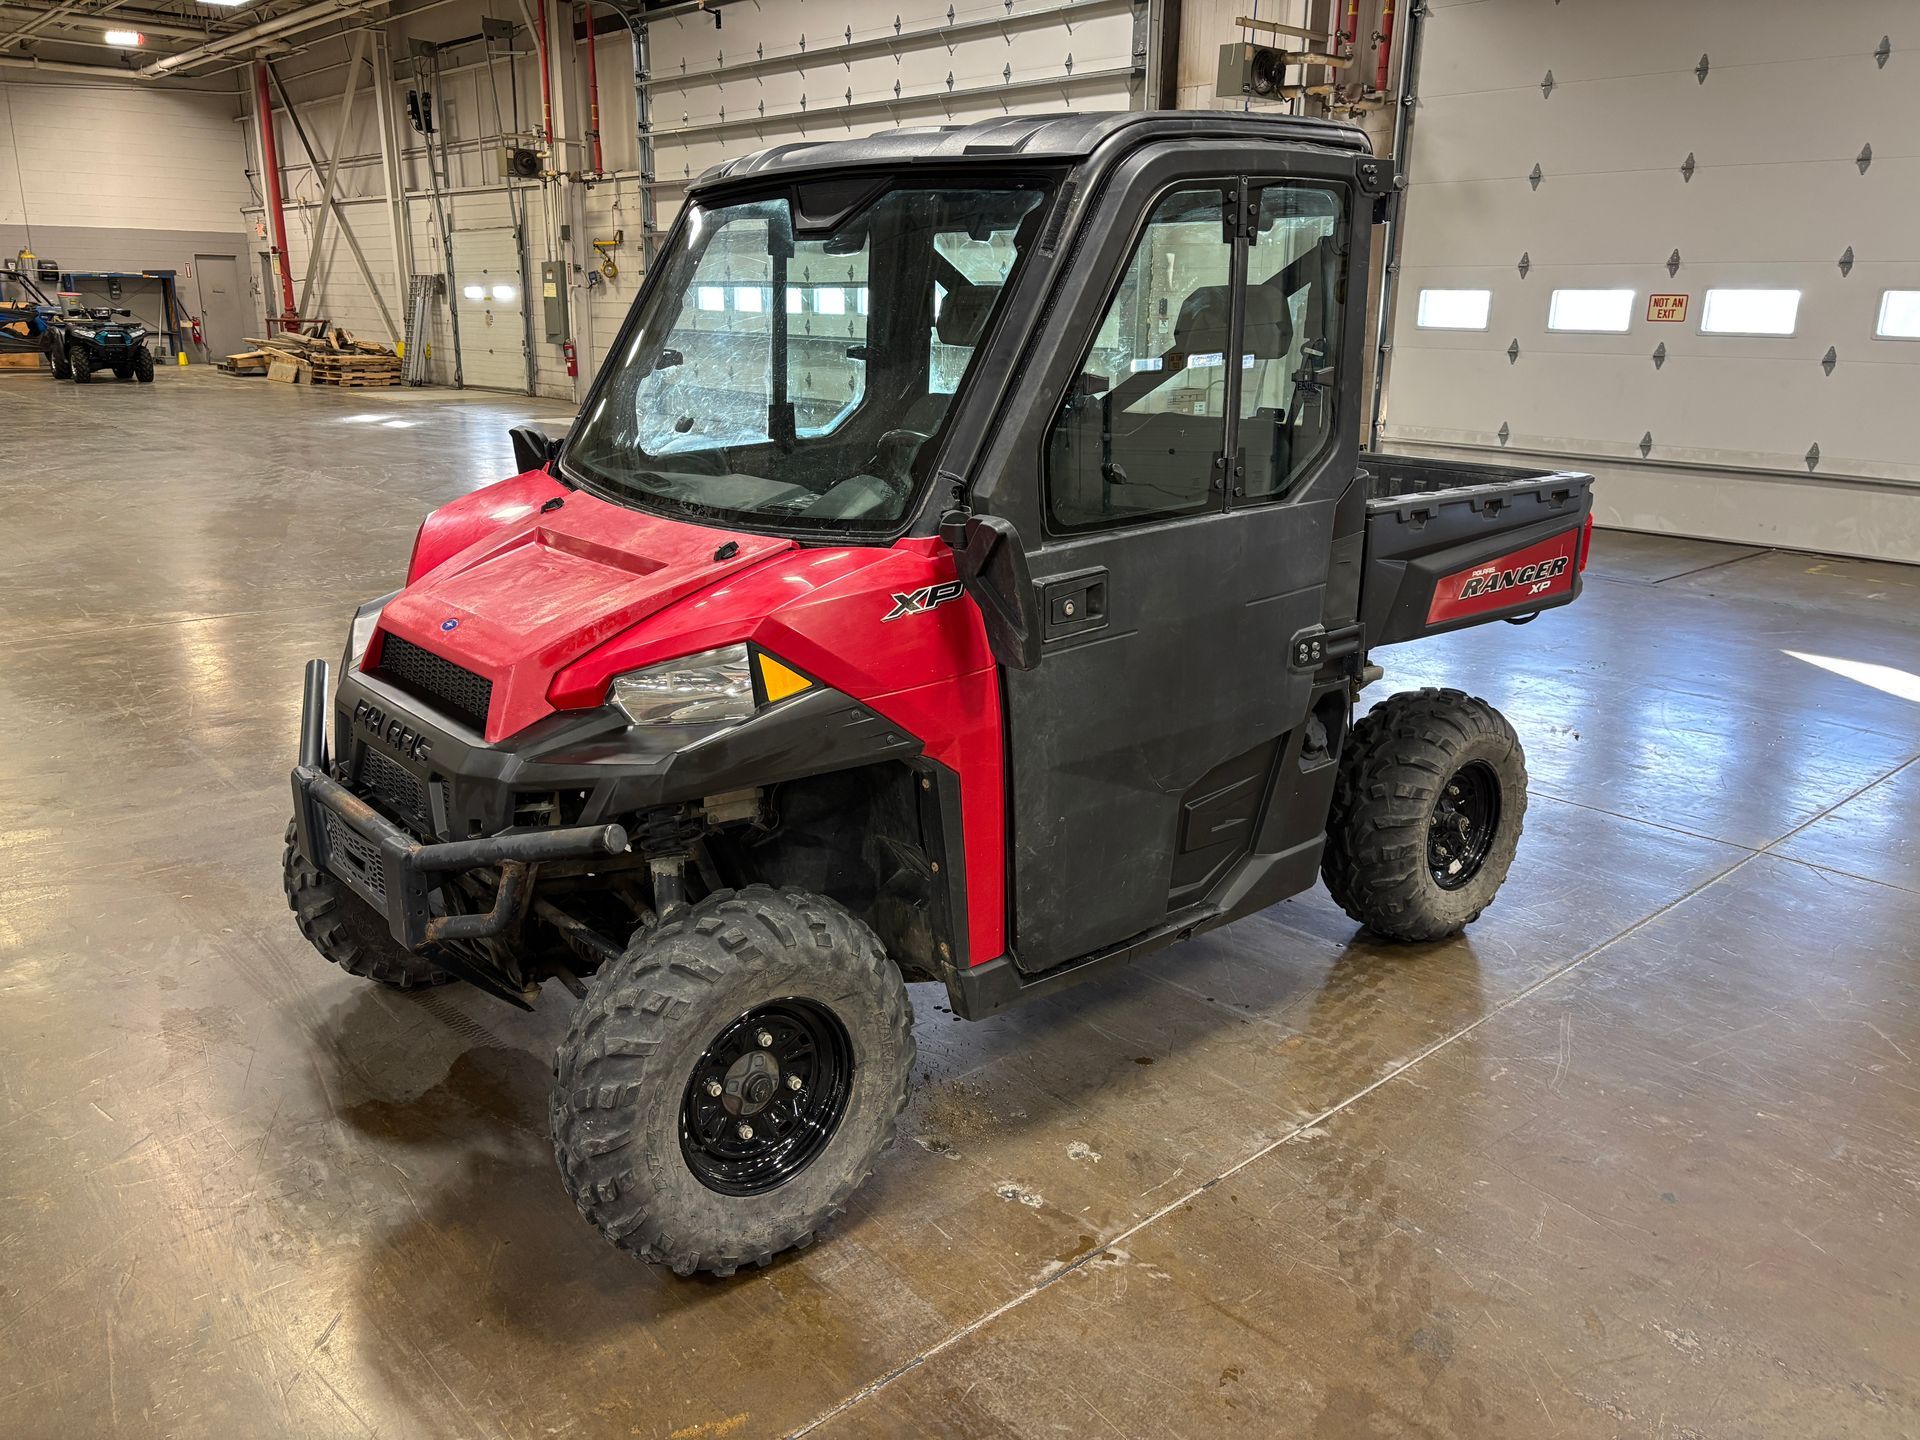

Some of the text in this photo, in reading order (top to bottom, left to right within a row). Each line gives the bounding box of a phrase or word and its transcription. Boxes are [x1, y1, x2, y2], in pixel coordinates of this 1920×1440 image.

[1653, 298, 1684, 308] NOT AN
[1657, 309, 1676, 319] EXIT
[1458, 556, 1569, 600] RANGER
[1472, 566, 1496, 577] POLARIS
[1528, 580, 1551, 595] XP
[880, 580, 965, 622] XP
[353, 698, 434, 765] POLARIS
